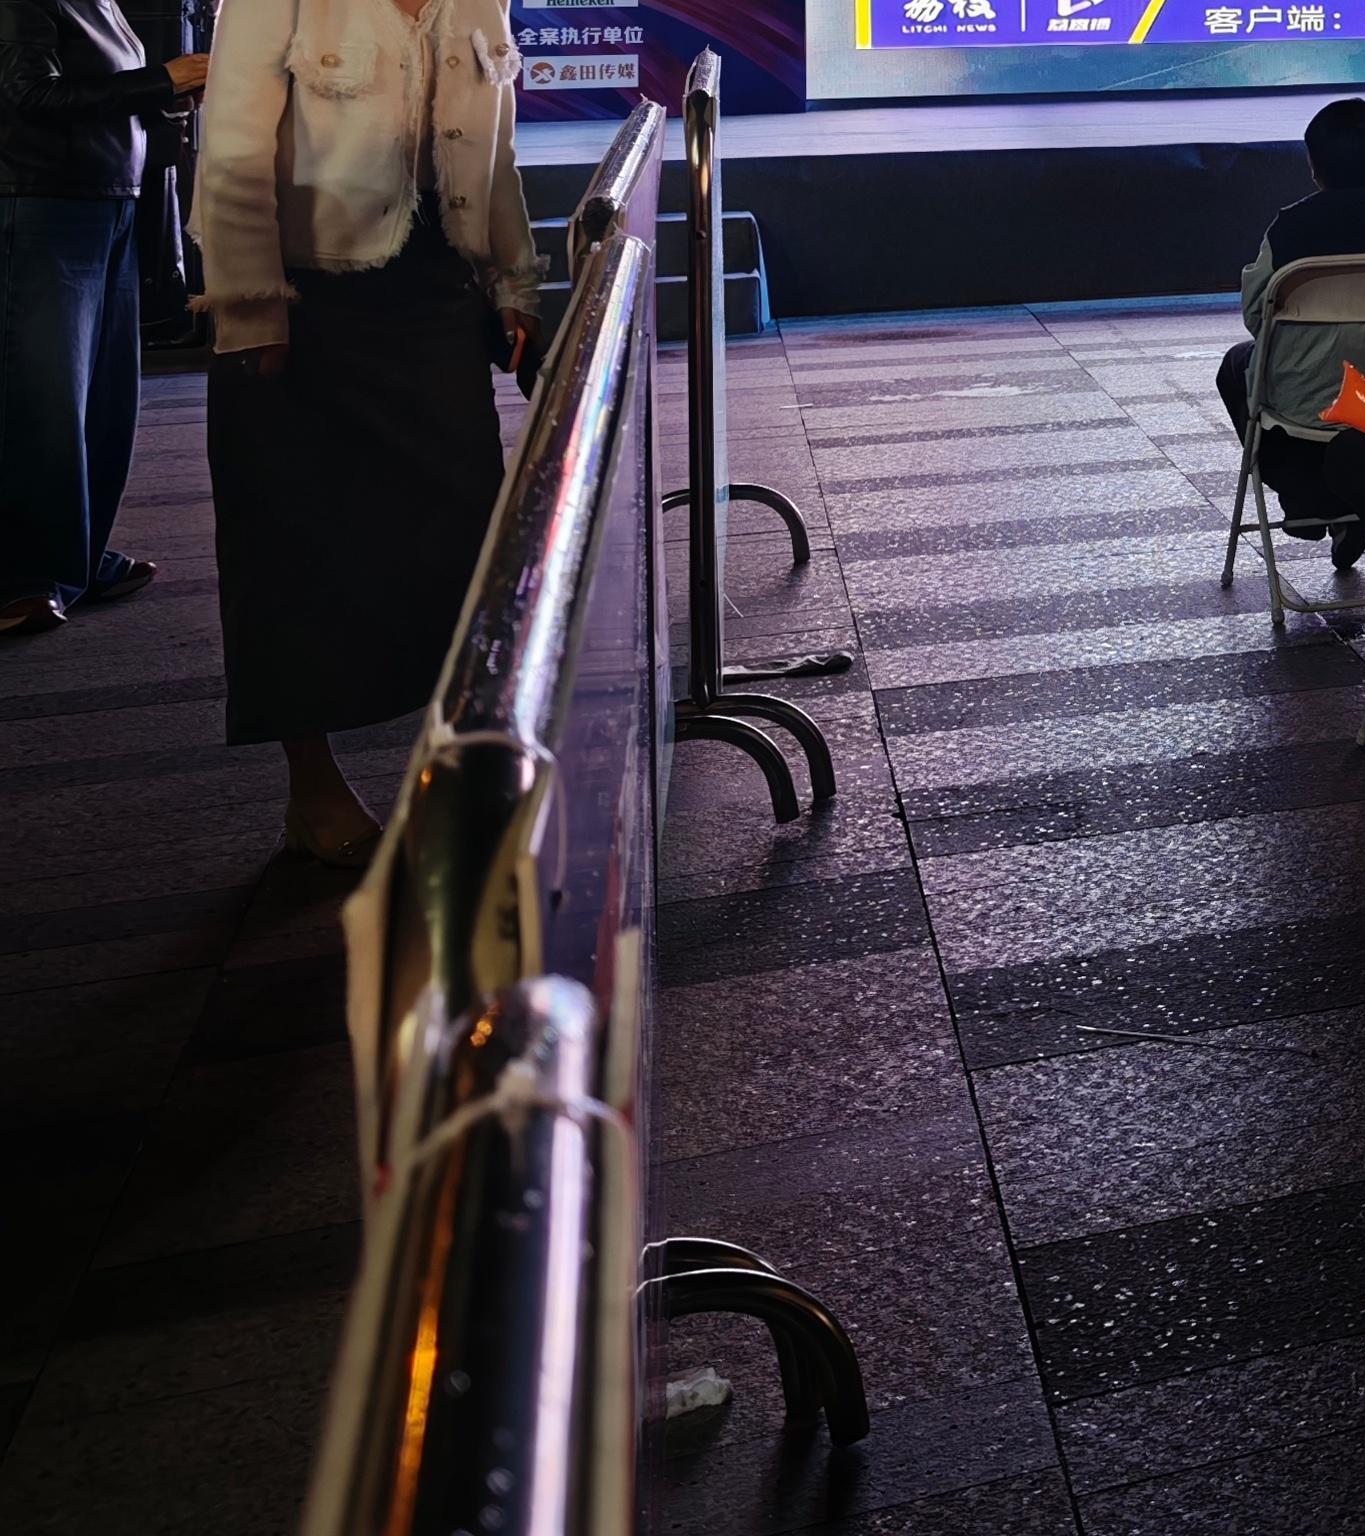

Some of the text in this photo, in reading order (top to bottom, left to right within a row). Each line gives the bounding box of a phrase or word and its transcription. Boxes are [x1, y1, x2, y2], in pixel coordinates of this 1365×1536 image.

[518, 26, 644, 46] 全案执行单位
[902, 24, 997, 33] LITCHI NEWS
[559, 63, 636, 81] 鑫田传媒
